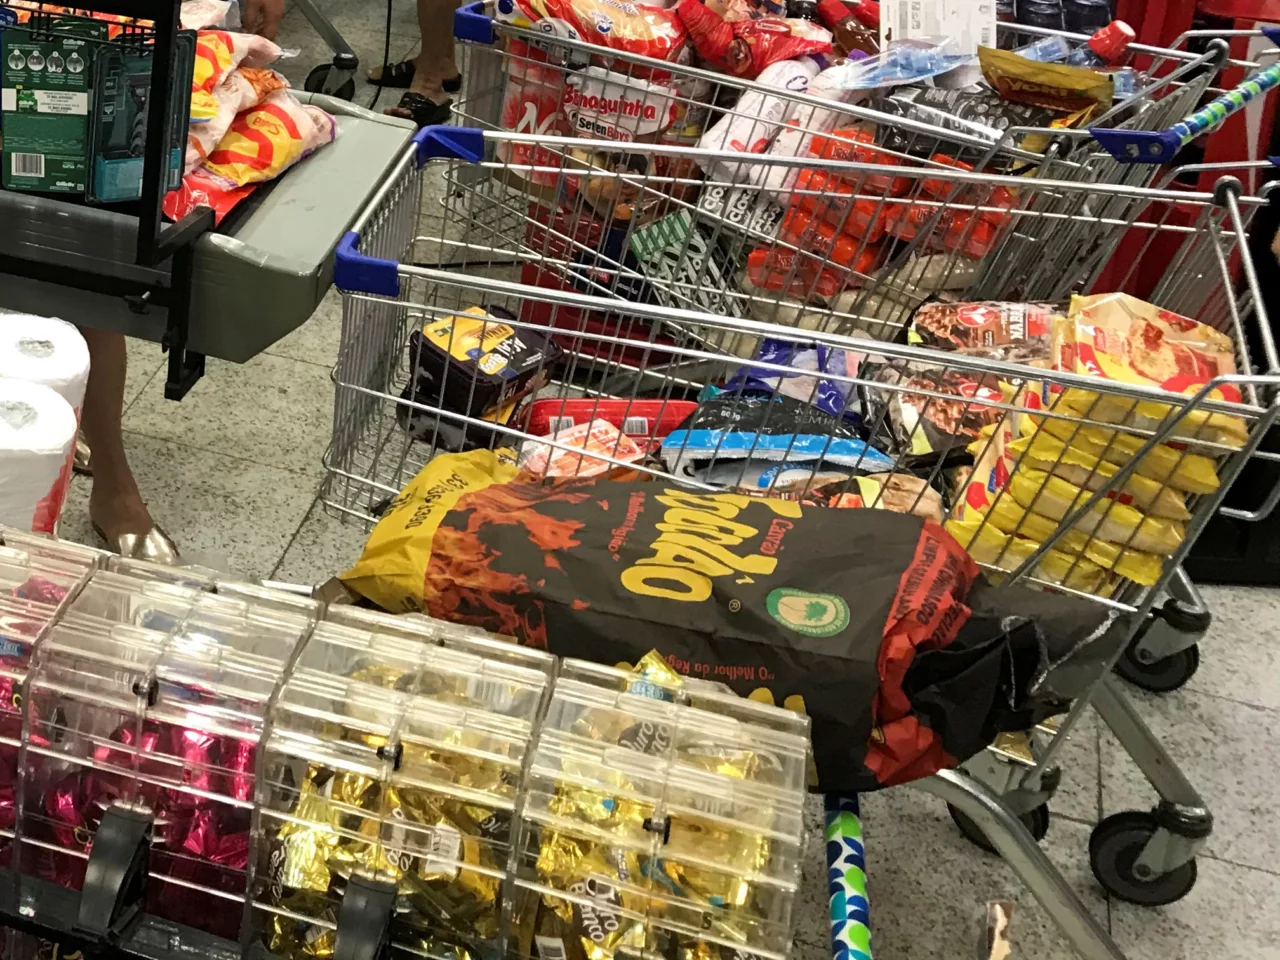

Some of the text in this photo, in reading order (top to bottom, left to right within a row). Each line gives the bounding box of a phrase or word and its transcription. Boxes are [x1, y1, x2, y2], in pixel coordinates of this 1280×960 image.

[56, 180, 76, 188] Gillette
[760, 518, 795, 558] Carvão
[694, 663, 710, 677] da
[713, 663, 755, 682] Melhor
